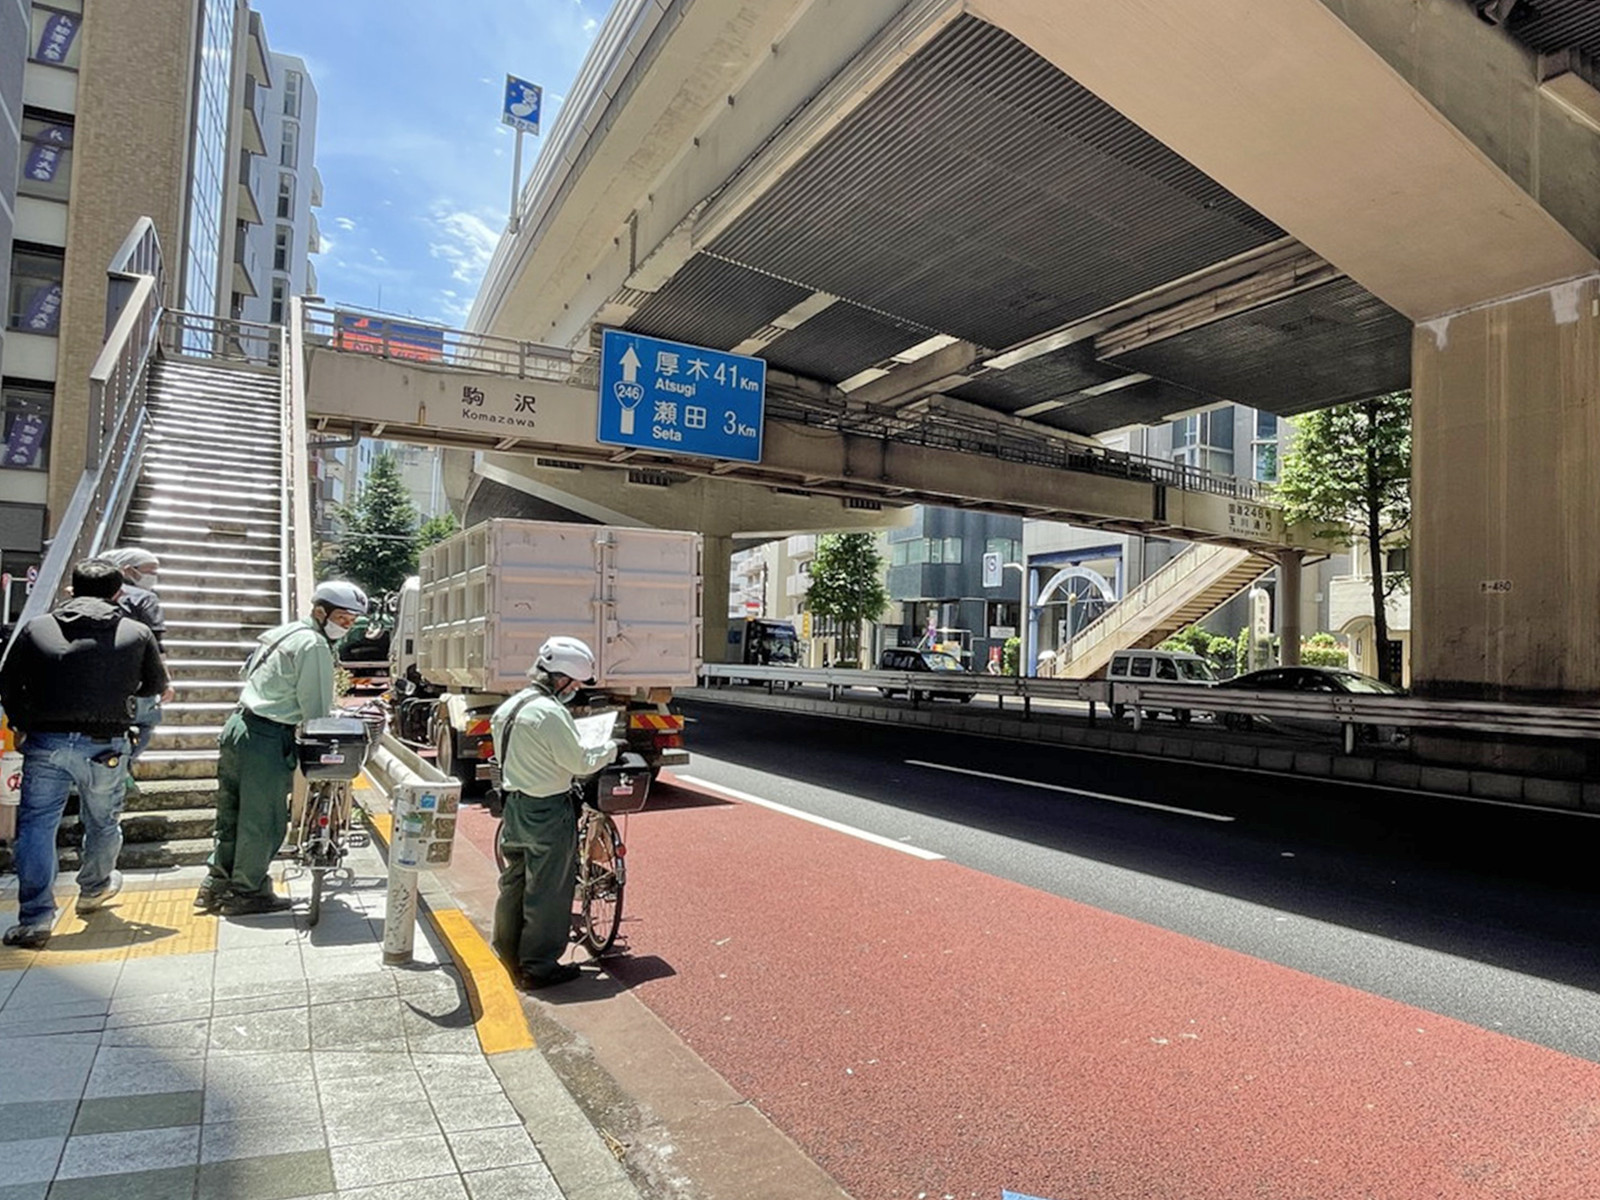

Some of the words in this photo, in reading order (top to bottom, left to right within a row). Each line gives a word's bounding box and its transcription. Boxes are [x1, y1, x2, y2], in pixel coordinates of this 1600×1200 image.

[655, 351, 710, 381] 厚木
[713, 362, 739, 388] 41
[740, 377, 760, 392] Km
[617, 385, 641, 401] 246
[655, 378, 697, 398] Atsugi
[461, 385, 536, 414] 駒沢
[462, 408, 536, 428] Komazawa
[653, 400, 707, 430] 瀬田
[722, 411, 738, 435] 3
[738, 424, 757, 438] Km
[652, 426, 682, 442] Seta
